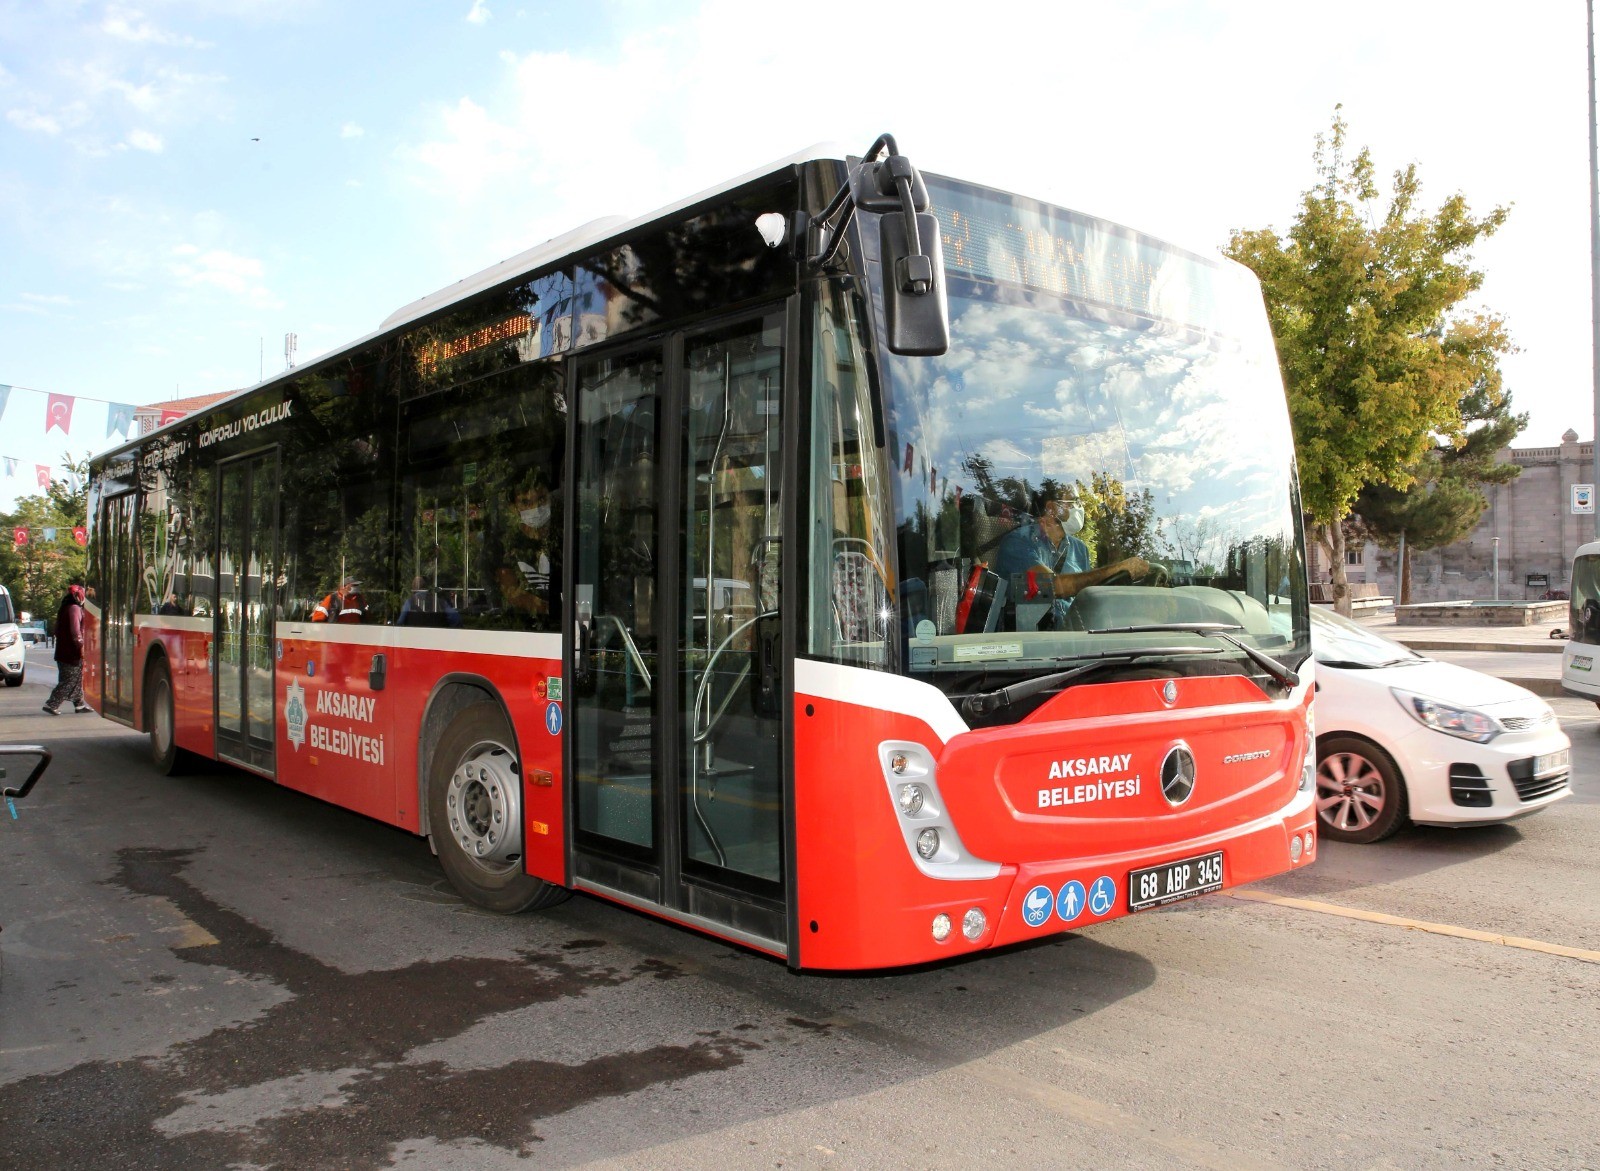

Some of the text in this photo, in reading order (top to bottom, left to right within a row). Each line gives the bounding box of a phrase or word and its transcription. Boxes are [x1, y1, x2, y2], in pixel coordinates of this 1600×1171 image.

[199, 420, 241, 449] KONFORLU
[242, 399, 293, 433] YOLCULUK
[316, 689, 376, 723] AKSARAY
[310, 724, 384, 766] BELEDİYESİ
[1048, 753, 1132, 779] AKSARAY
[1038, 774, 1141, 808] BELEDİYESİ
[1140, 856, 1221, 900] 68 ABP 345
